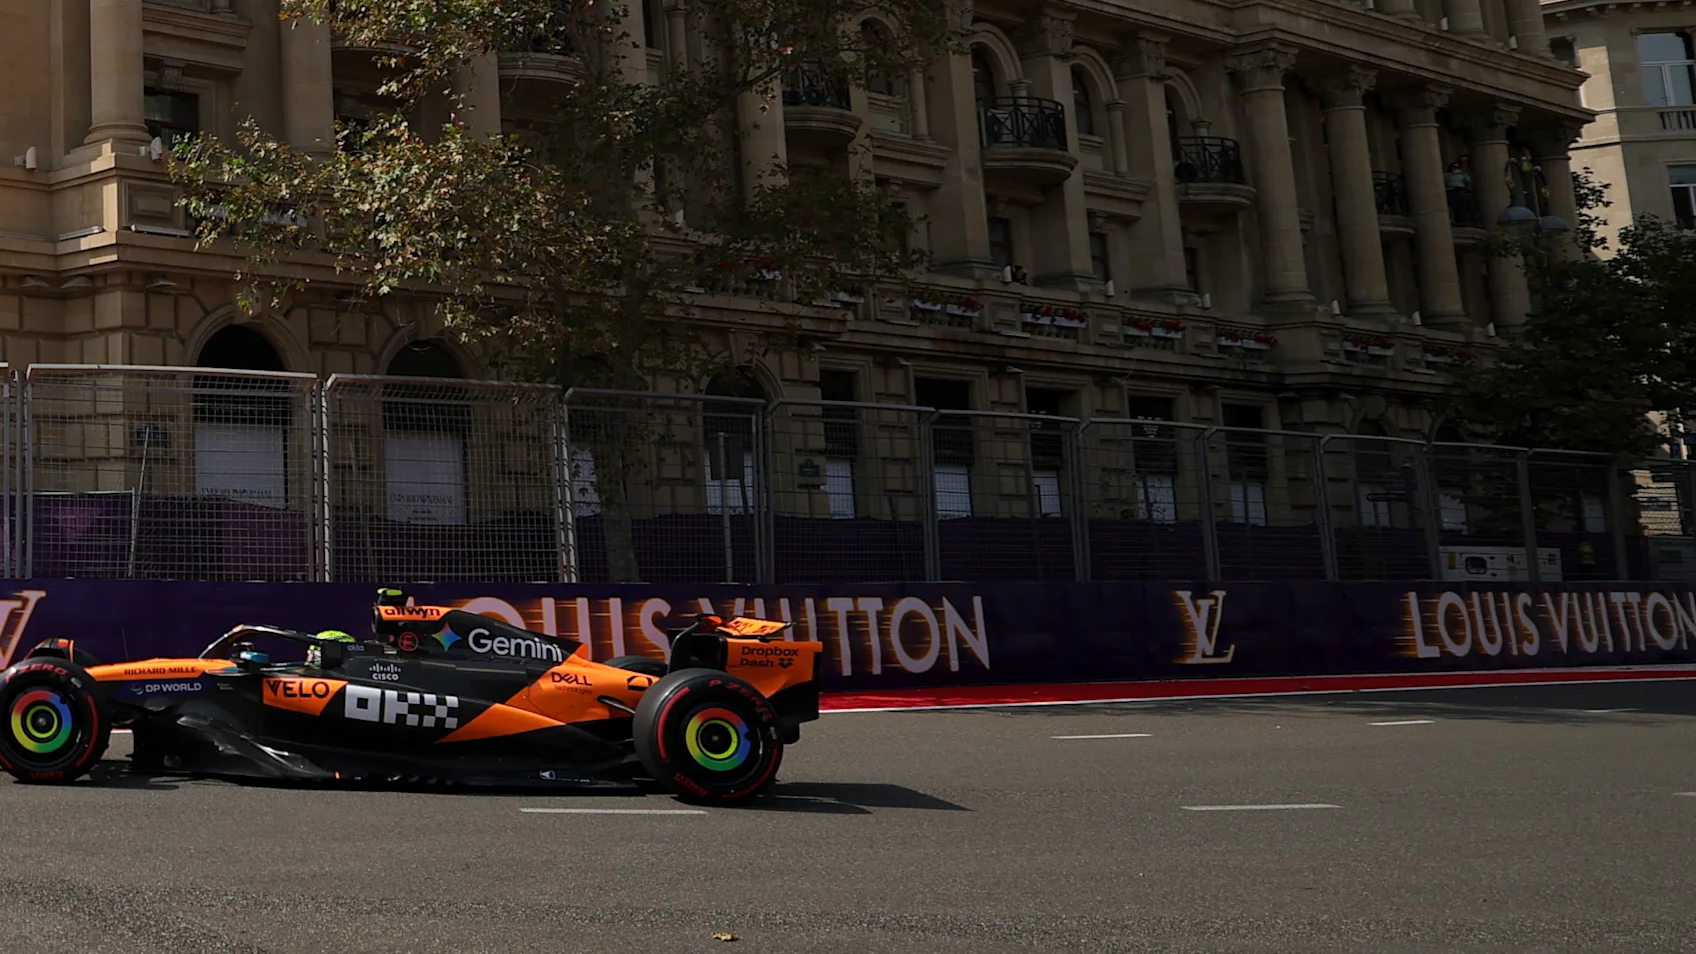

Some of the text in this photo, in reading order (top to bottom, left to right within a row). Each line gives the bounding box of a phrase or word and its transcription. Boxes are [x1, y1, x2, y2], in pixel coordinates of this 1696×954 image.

[384, 606, 441, 619] allwyn
[1407, 590, 1541, 658] LOUIS
[467, 627, 563, 663] Gemini
[741, 645, 800, 658] Dropbox
[740, 657, 774, 668] Dash
[17, 663, 69, 677] ZERO
[124, 666, 198, 676] RICHARD MILLE
[552, 671, 593, 687] DELL
[145, 682, 203, 693] DP WORLD
[266, 680, 331, 698] VELO
[344, 684, 459, 729] OKX
